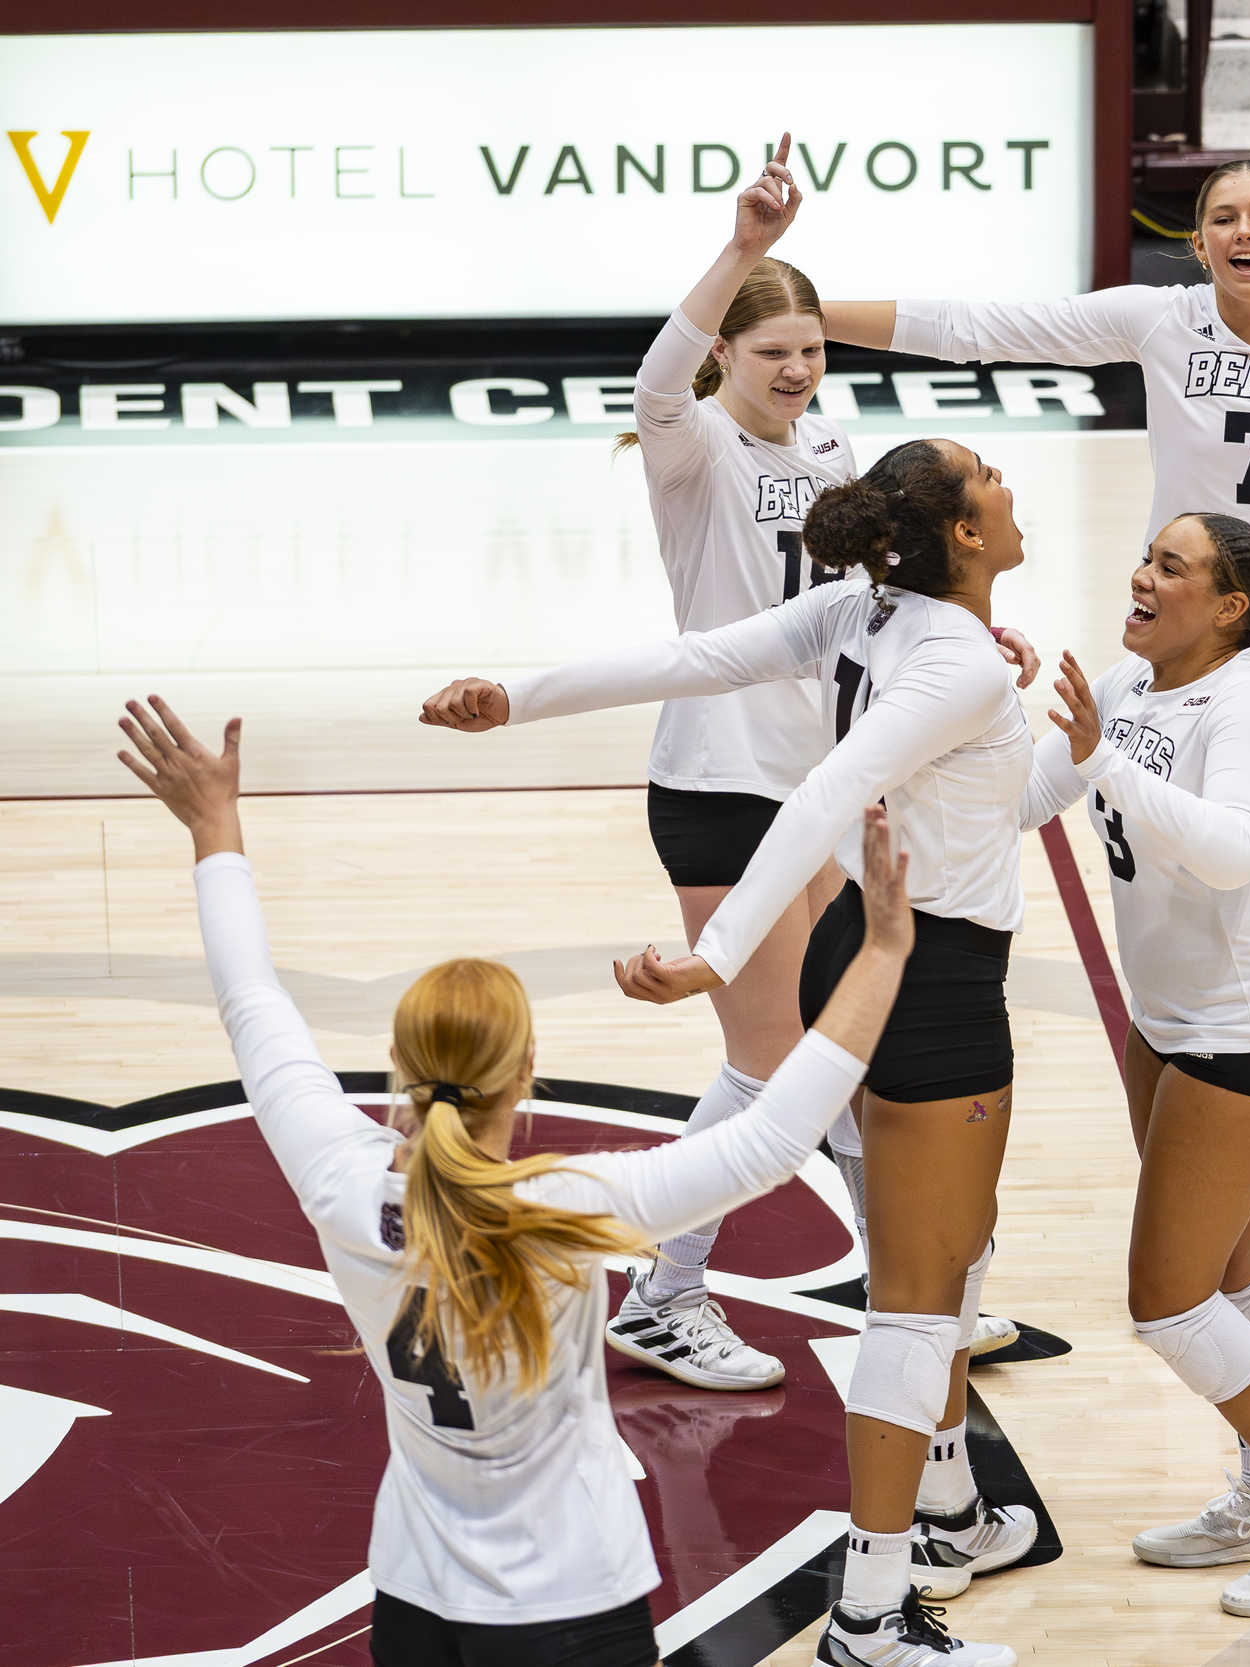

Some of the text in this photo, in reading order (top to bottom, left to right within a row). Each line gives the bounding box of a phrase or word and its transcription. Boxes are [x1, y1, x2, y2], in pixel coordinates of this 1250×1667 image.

[7, 130, 91, 226] V
[128, 145, 436, 201] HOTEL
[449, 370, 1105, 426] CETER
[756, 475, 836, 523] BEA
[1095, 788, 1137, 883] 3
[386, 1284, 476, 1431] 4
